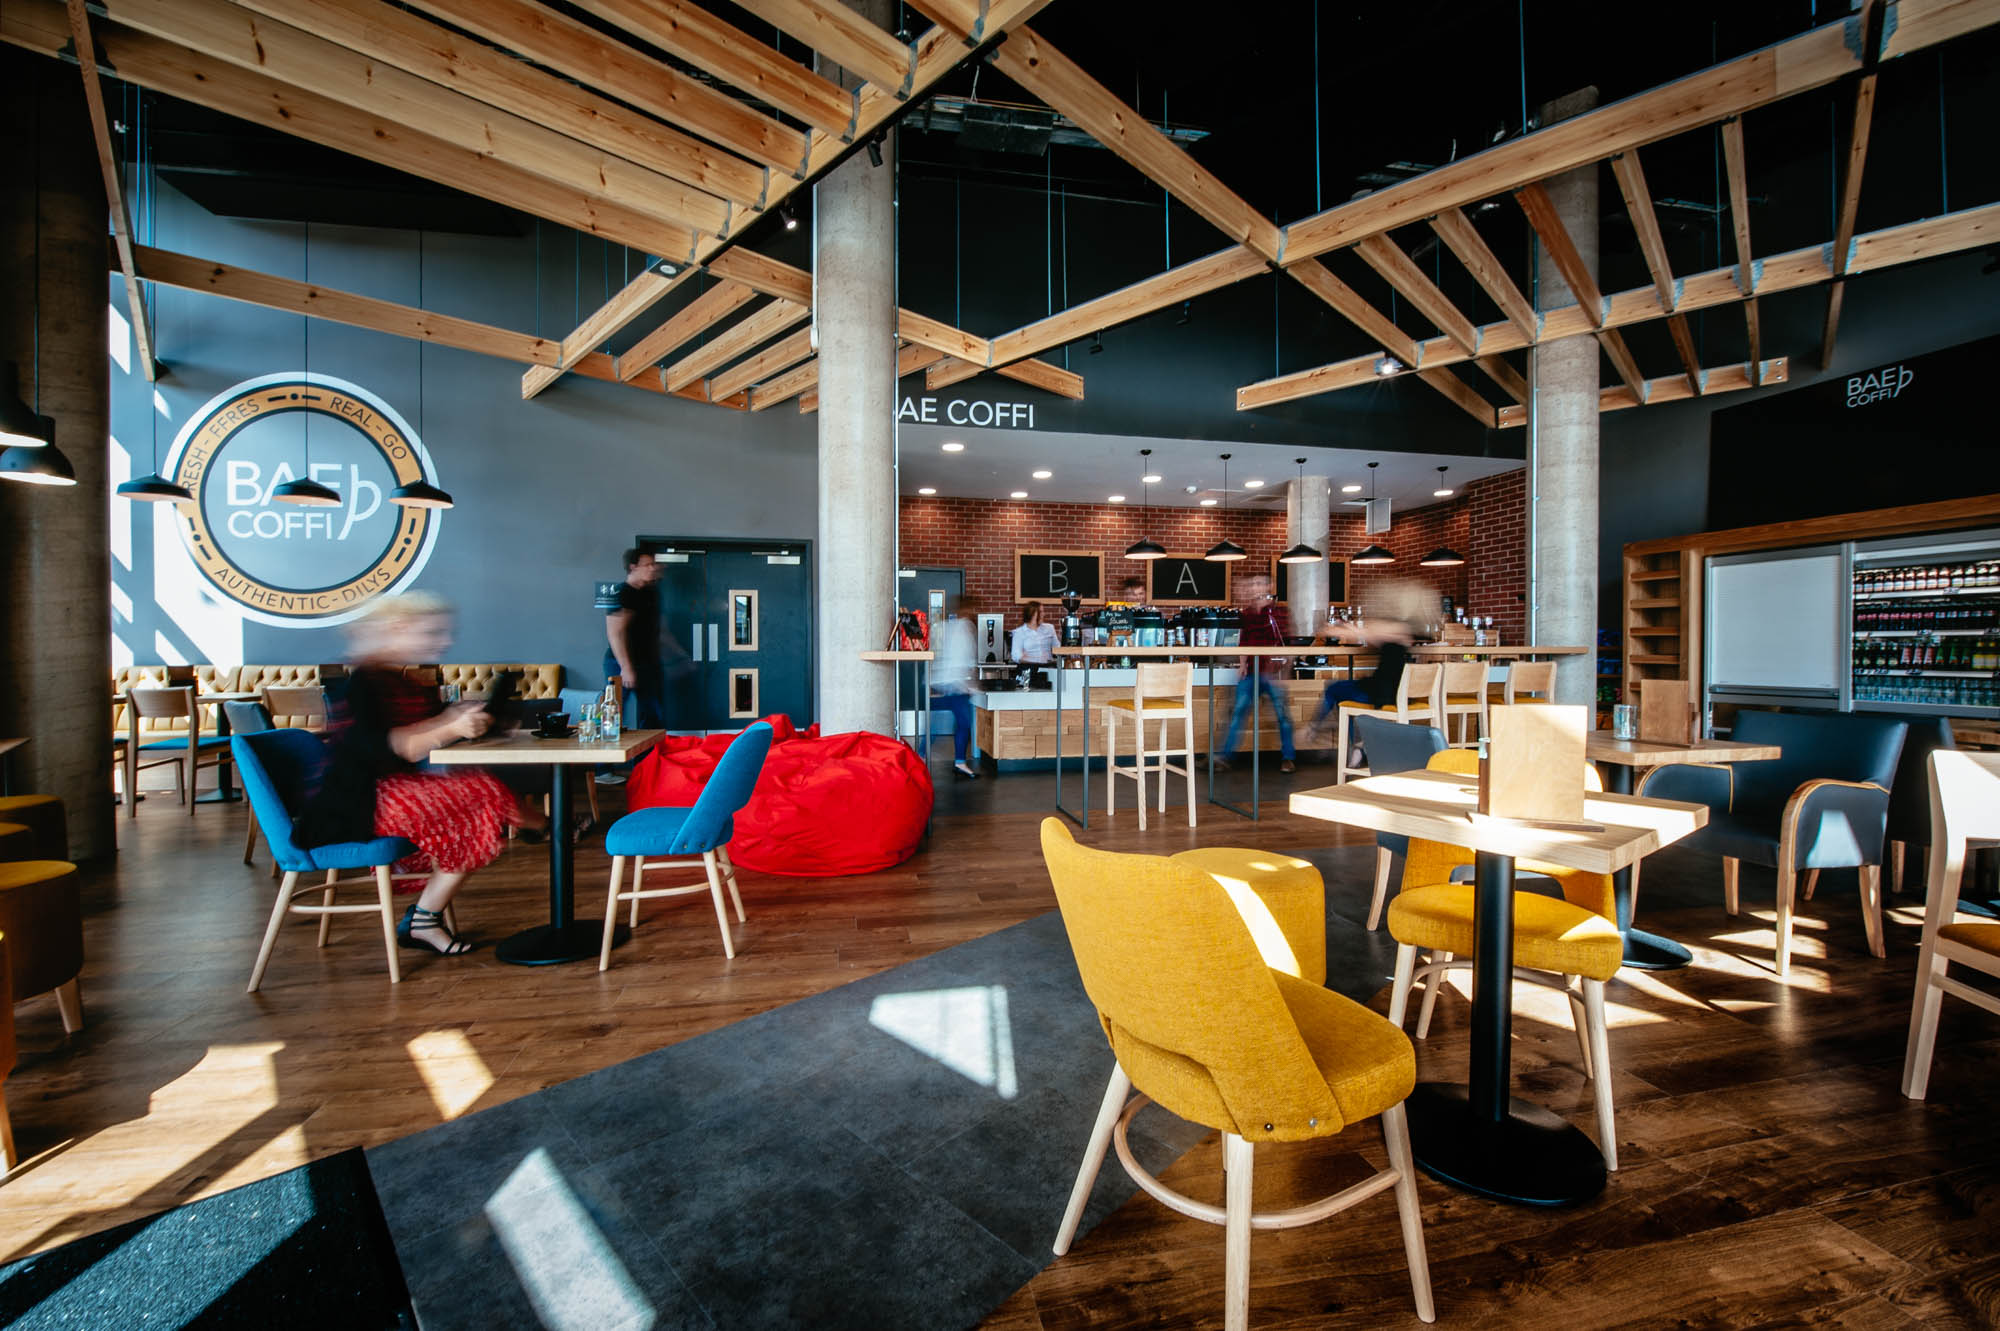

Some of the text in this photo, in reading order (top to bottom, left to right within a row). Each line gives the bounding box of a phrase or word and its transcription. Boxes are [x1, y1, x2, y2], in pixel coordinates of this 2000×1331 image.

[1846, 387, 1892, 408] COFFI
[1847, 367, 1897, 397] BAE
[329, 396, 407, 460] REAL GO
[897, 396, 1034, 428] AE COFFI
[181, 398, 260, 491] RESH FFRES
[227, 509, 333, 541] COFFI
[214, 567, 391, 610] AUTHENTIC DILYS
[1049, 559, 1069, 593] B
[1175, 561, 1199, 595] A
